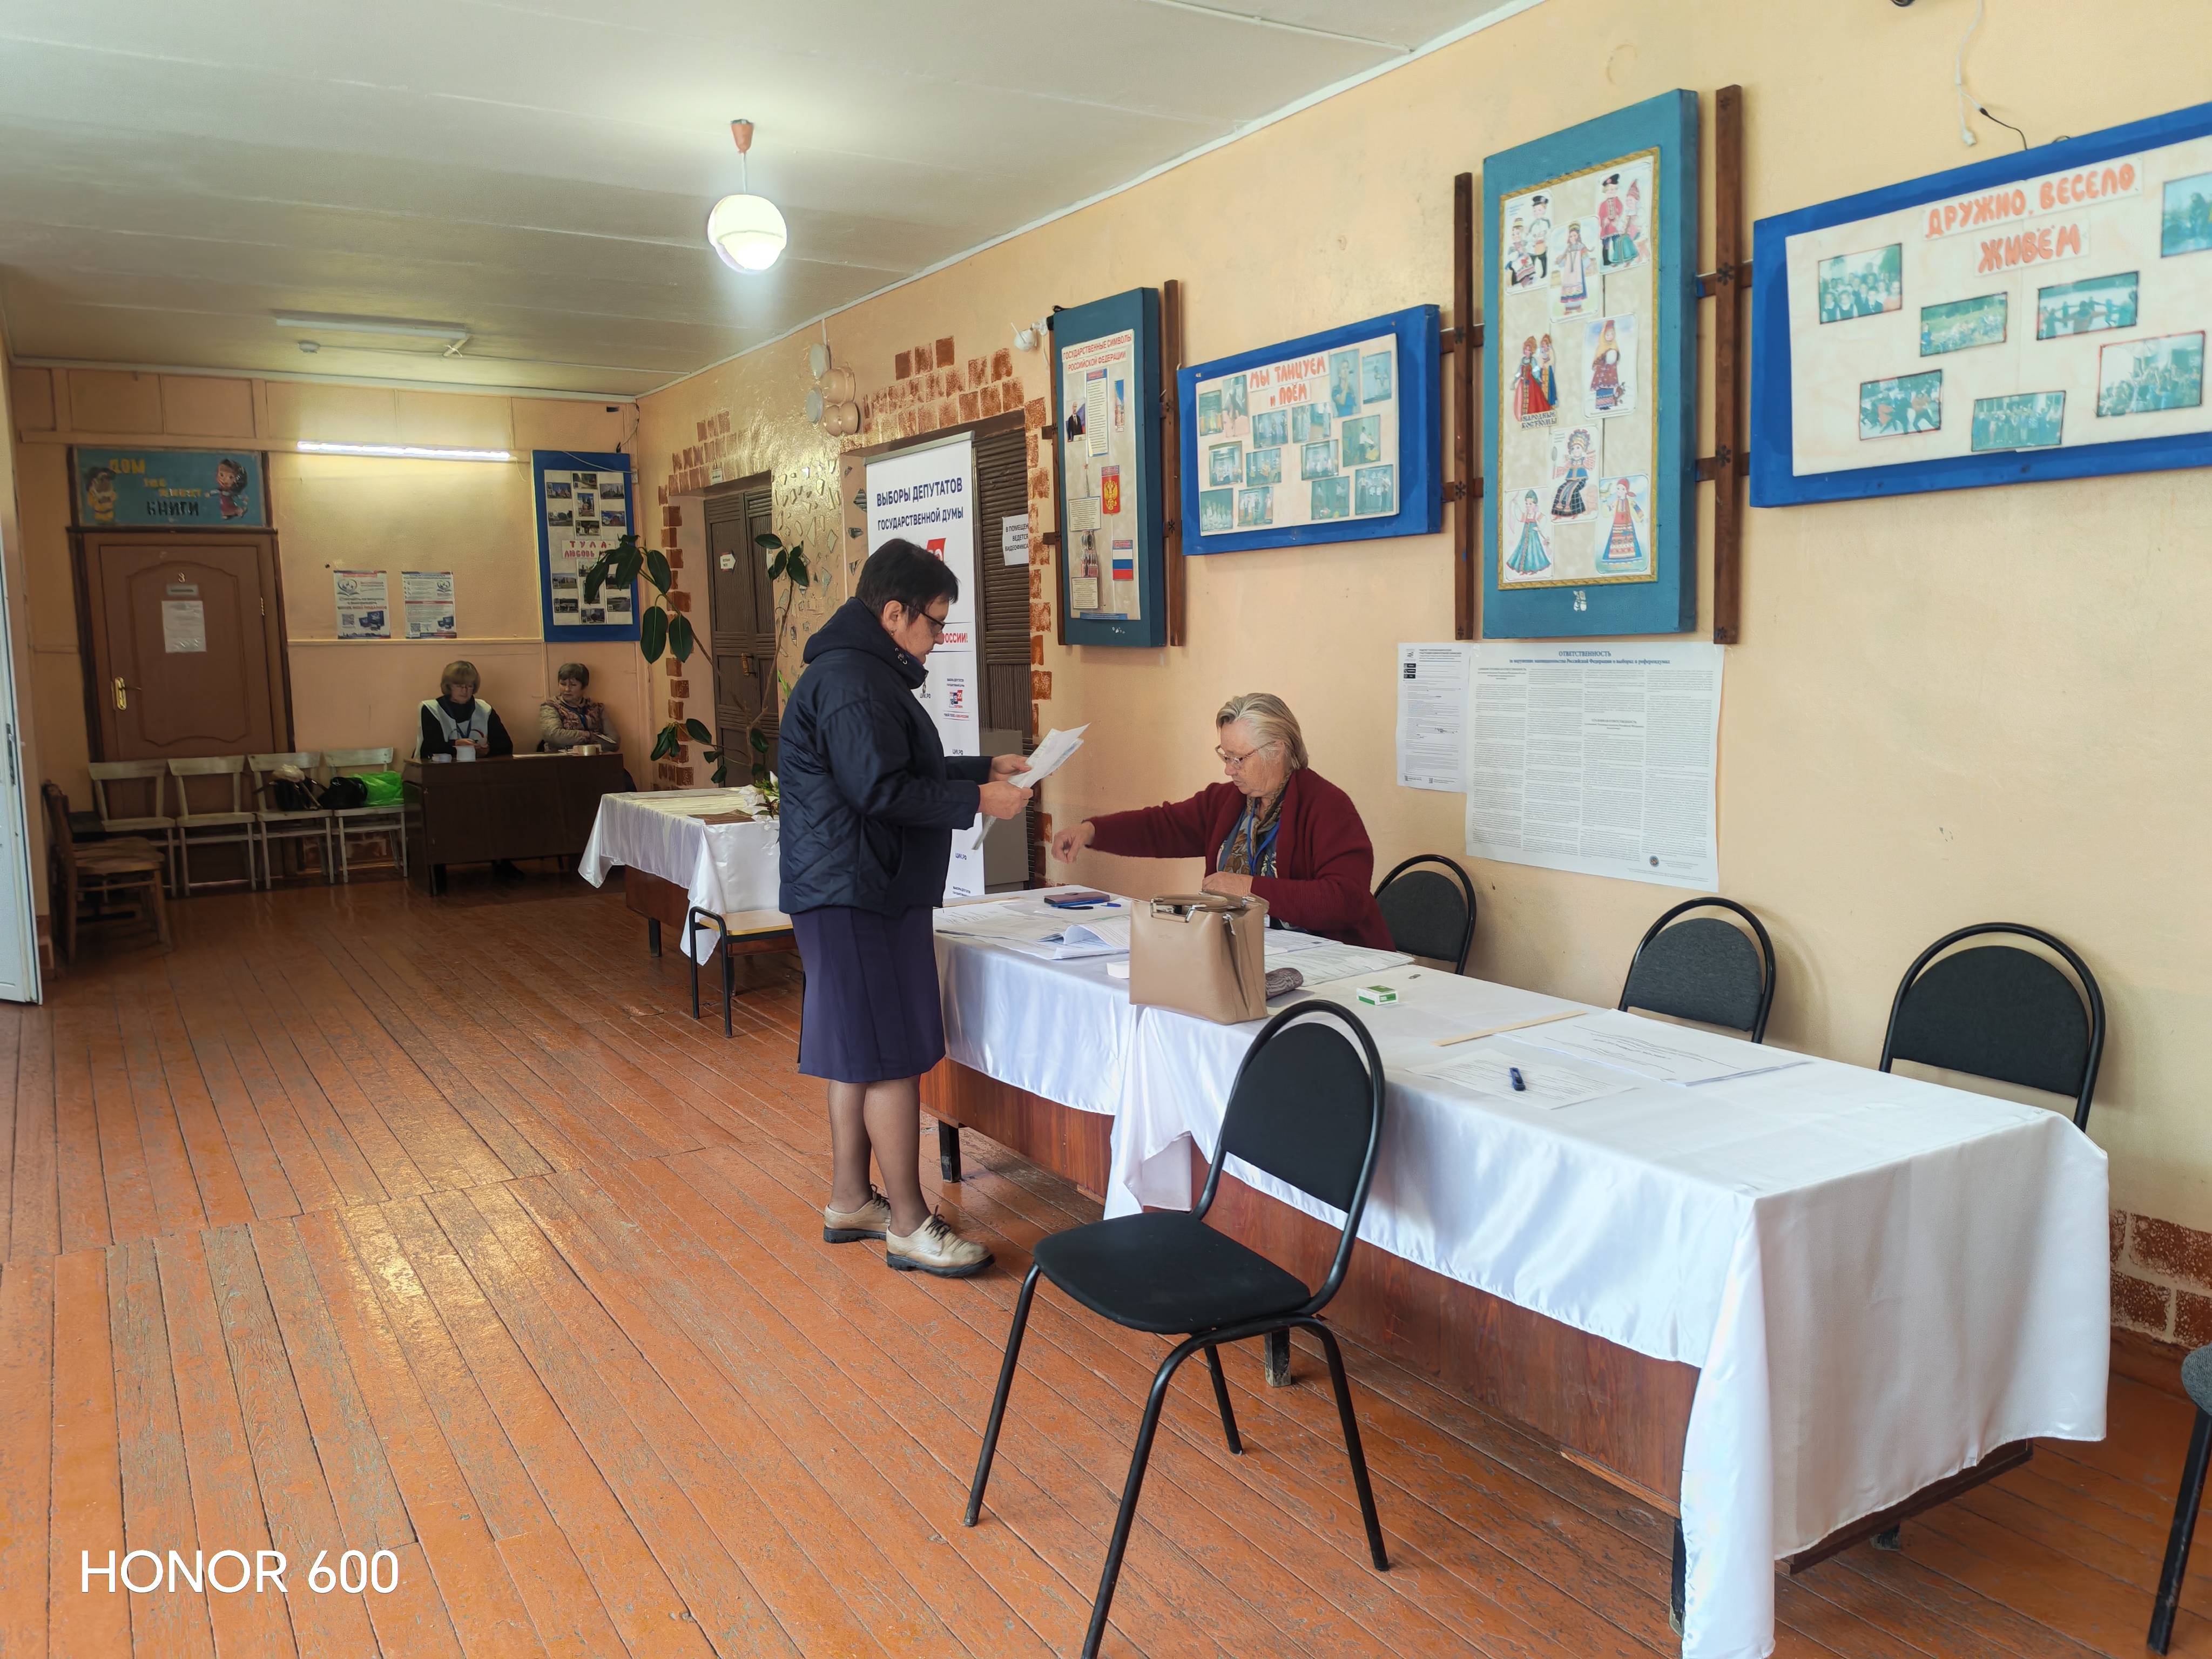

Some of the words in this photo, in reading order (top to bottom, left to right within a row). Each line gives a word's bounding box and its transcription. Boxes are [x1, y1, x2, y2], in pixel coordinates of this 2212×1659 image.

[1926, 189, 2033, 238] ДРУЖНО,
[2039, 163, 2135, 210] ВЕСЕЛО
[1978, 224, 2081, 273] ЖИВЁМ
[1063, 341, 1107, 360] ГОСУДАРСТВЕННЫЕ
[1108, 334, 1132, 347] СИМВОЛЫ
[1068, 356, 1097, 372] РОССИЙСКОЙ
[1098, 350, 1126, 363] ФЕДЕРАЦИИ
[1250, 369, 1269, 389] МЫ
[1274, 356, 1325, 382] ТАНЦУЕМ
[1279, 383, 1307, 404] ПОЁМ
[877, 487, 911, 507] ВЫБОРЫ
[913, 477, 962, 502] ДЕПУТАТОВ
[147, 500, 199, 516] КНИГИ
[878, 508, 940, 530] ГОСУДАРСТВЕННОЙ
[942, 507, 963, 523] ДУМЫ
[944, 632, 968, 643] ОССИИ!
